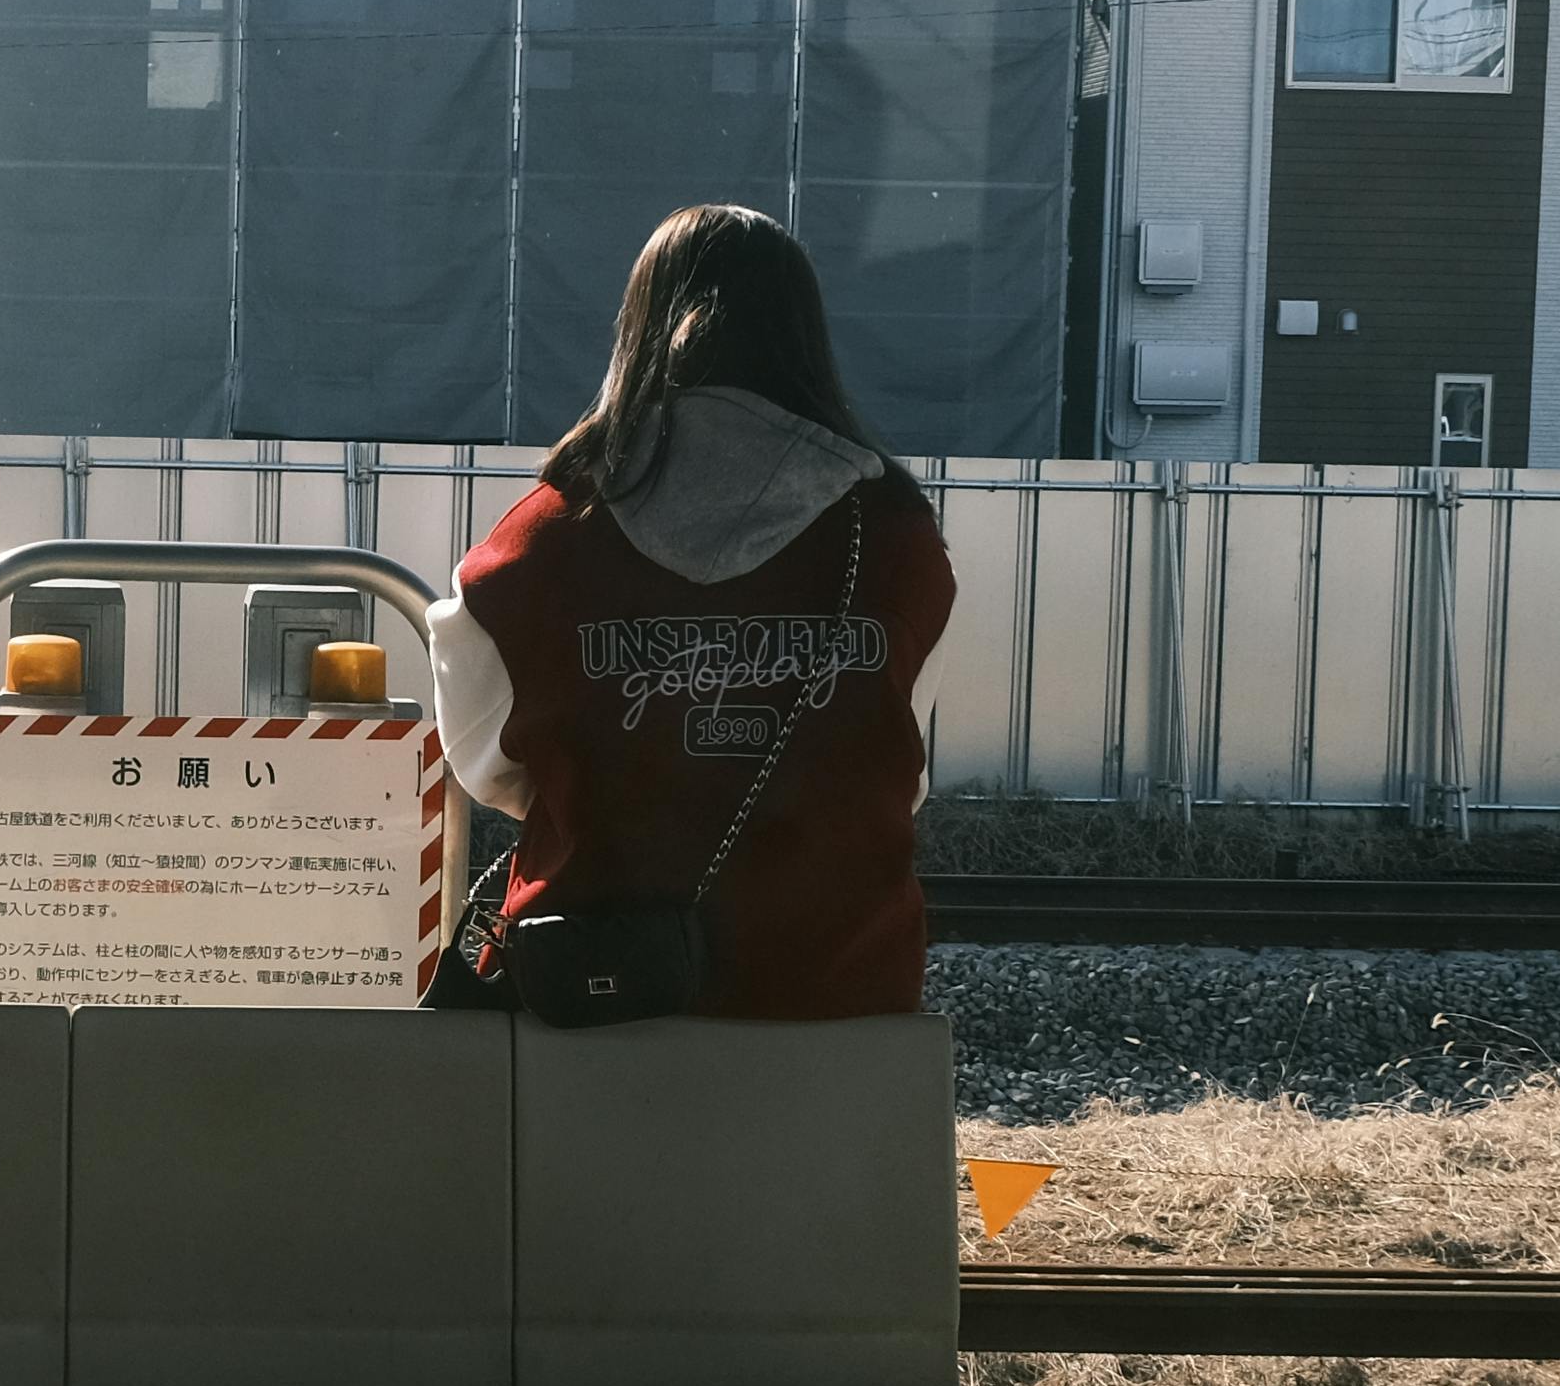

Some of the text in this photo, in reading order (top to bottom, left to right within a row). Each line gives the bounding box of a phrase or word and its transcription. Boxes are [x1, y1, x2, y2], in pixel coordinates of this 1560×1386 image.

[577, 615, 887, 680] UNSPECIFIED
[696, 717, 768, 746] 1990
[111, 756, 277, 789] お願い
